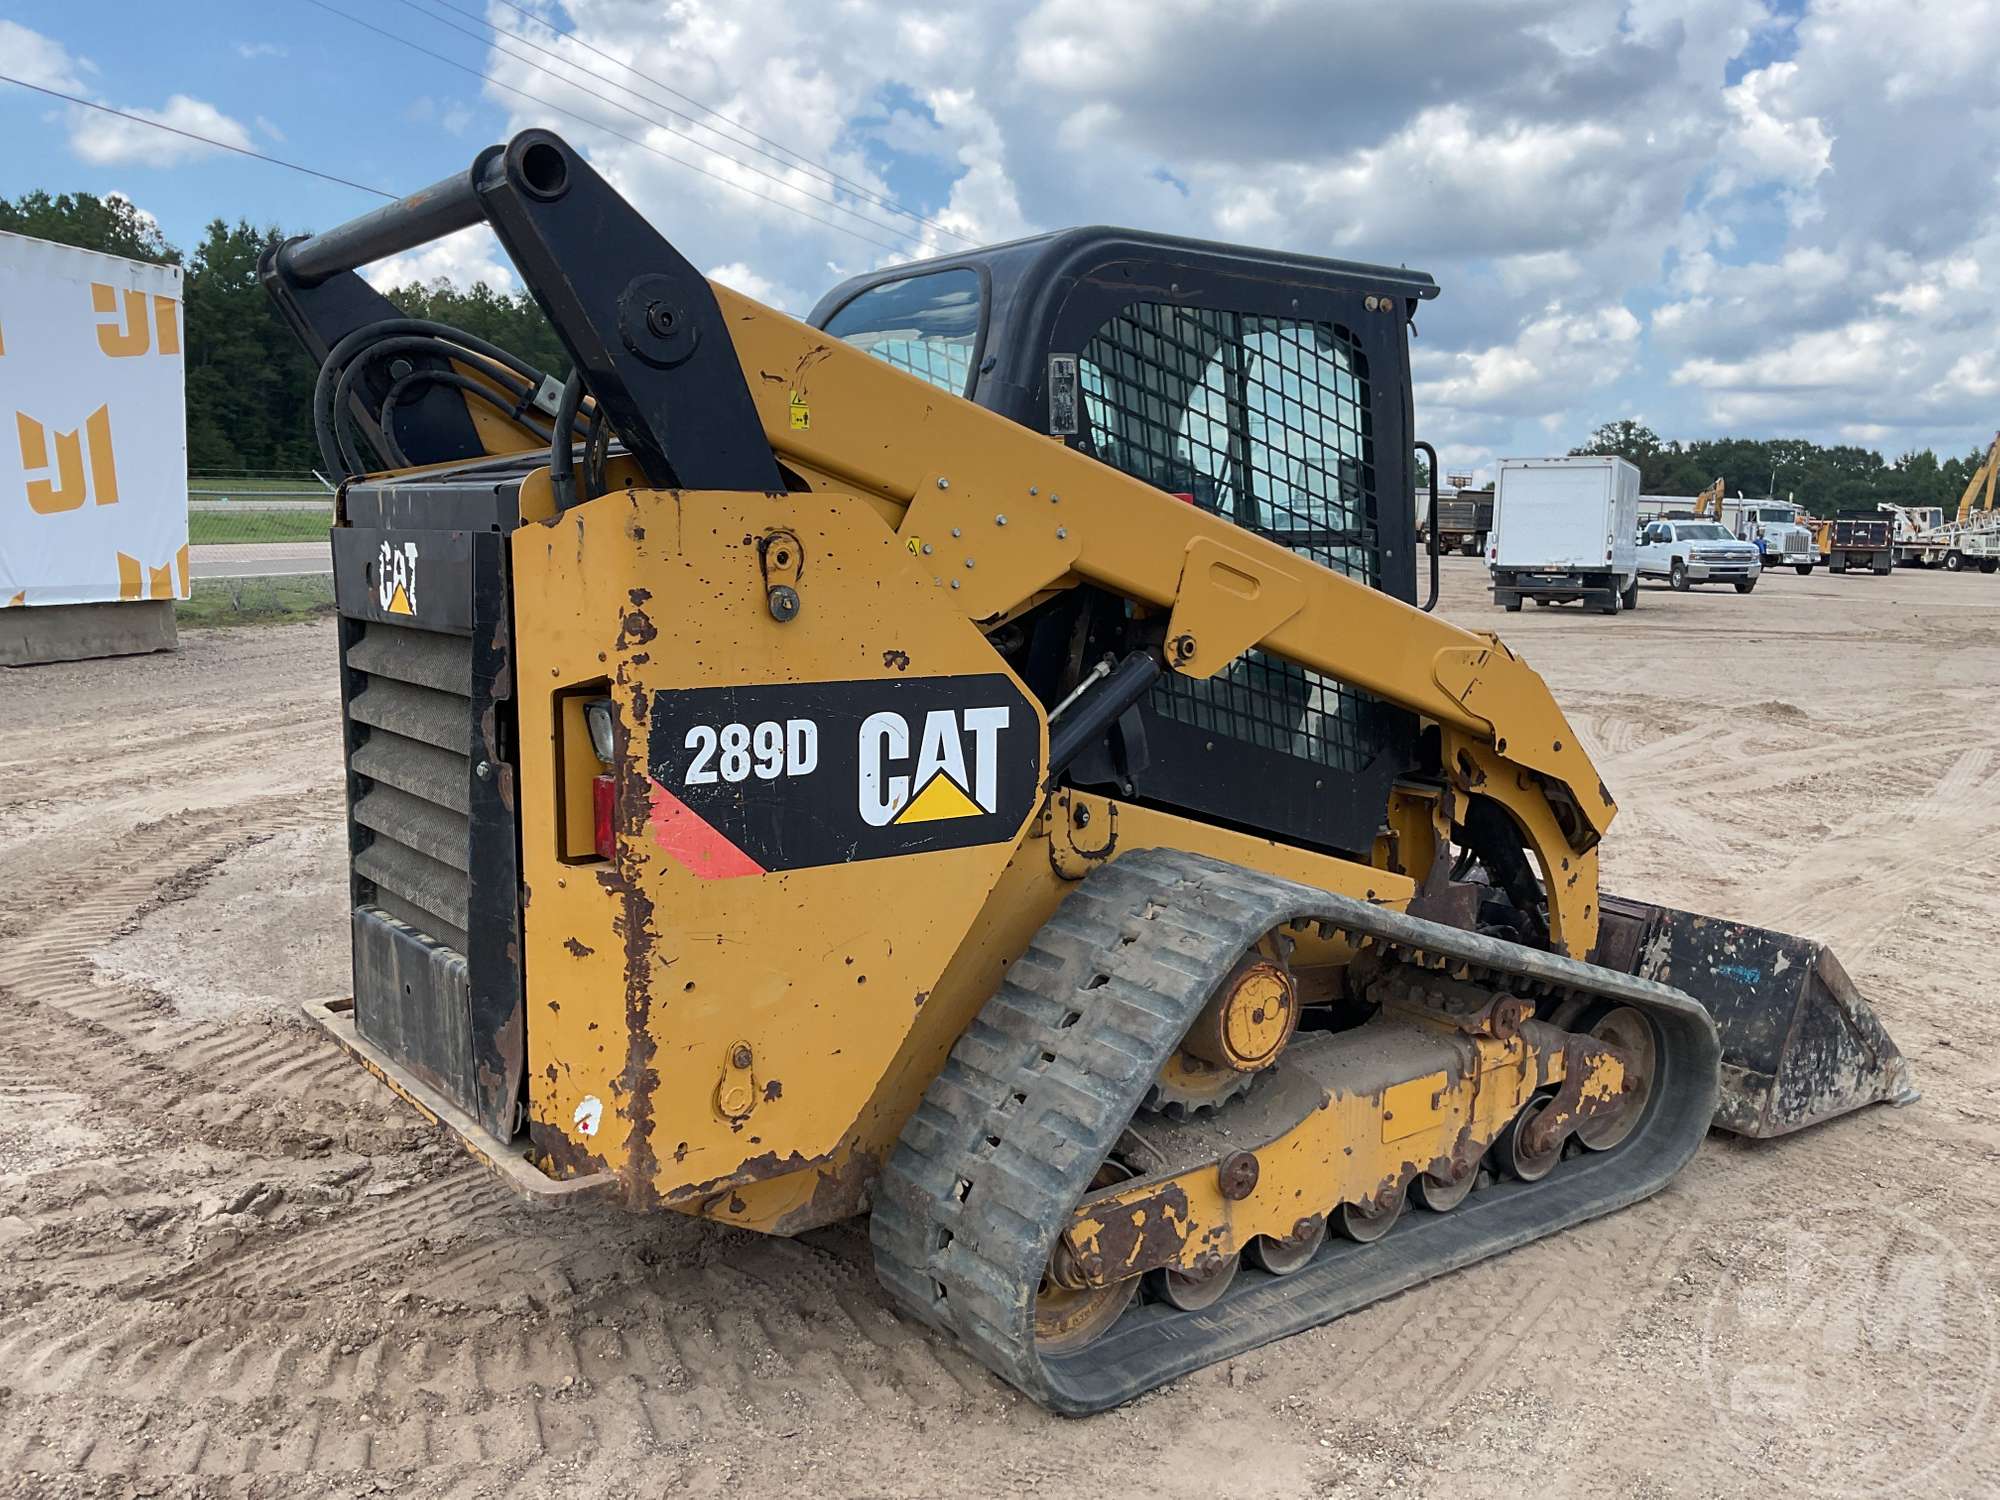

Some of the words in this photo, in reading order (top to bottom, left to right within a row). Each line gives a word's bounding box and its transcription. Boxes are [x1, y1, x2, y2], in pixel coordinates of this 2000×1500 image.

[379, 540, 418, 616] CAT
[684, 718, 818, 785] 289D
[859, 706, 1010, 827] CAT
